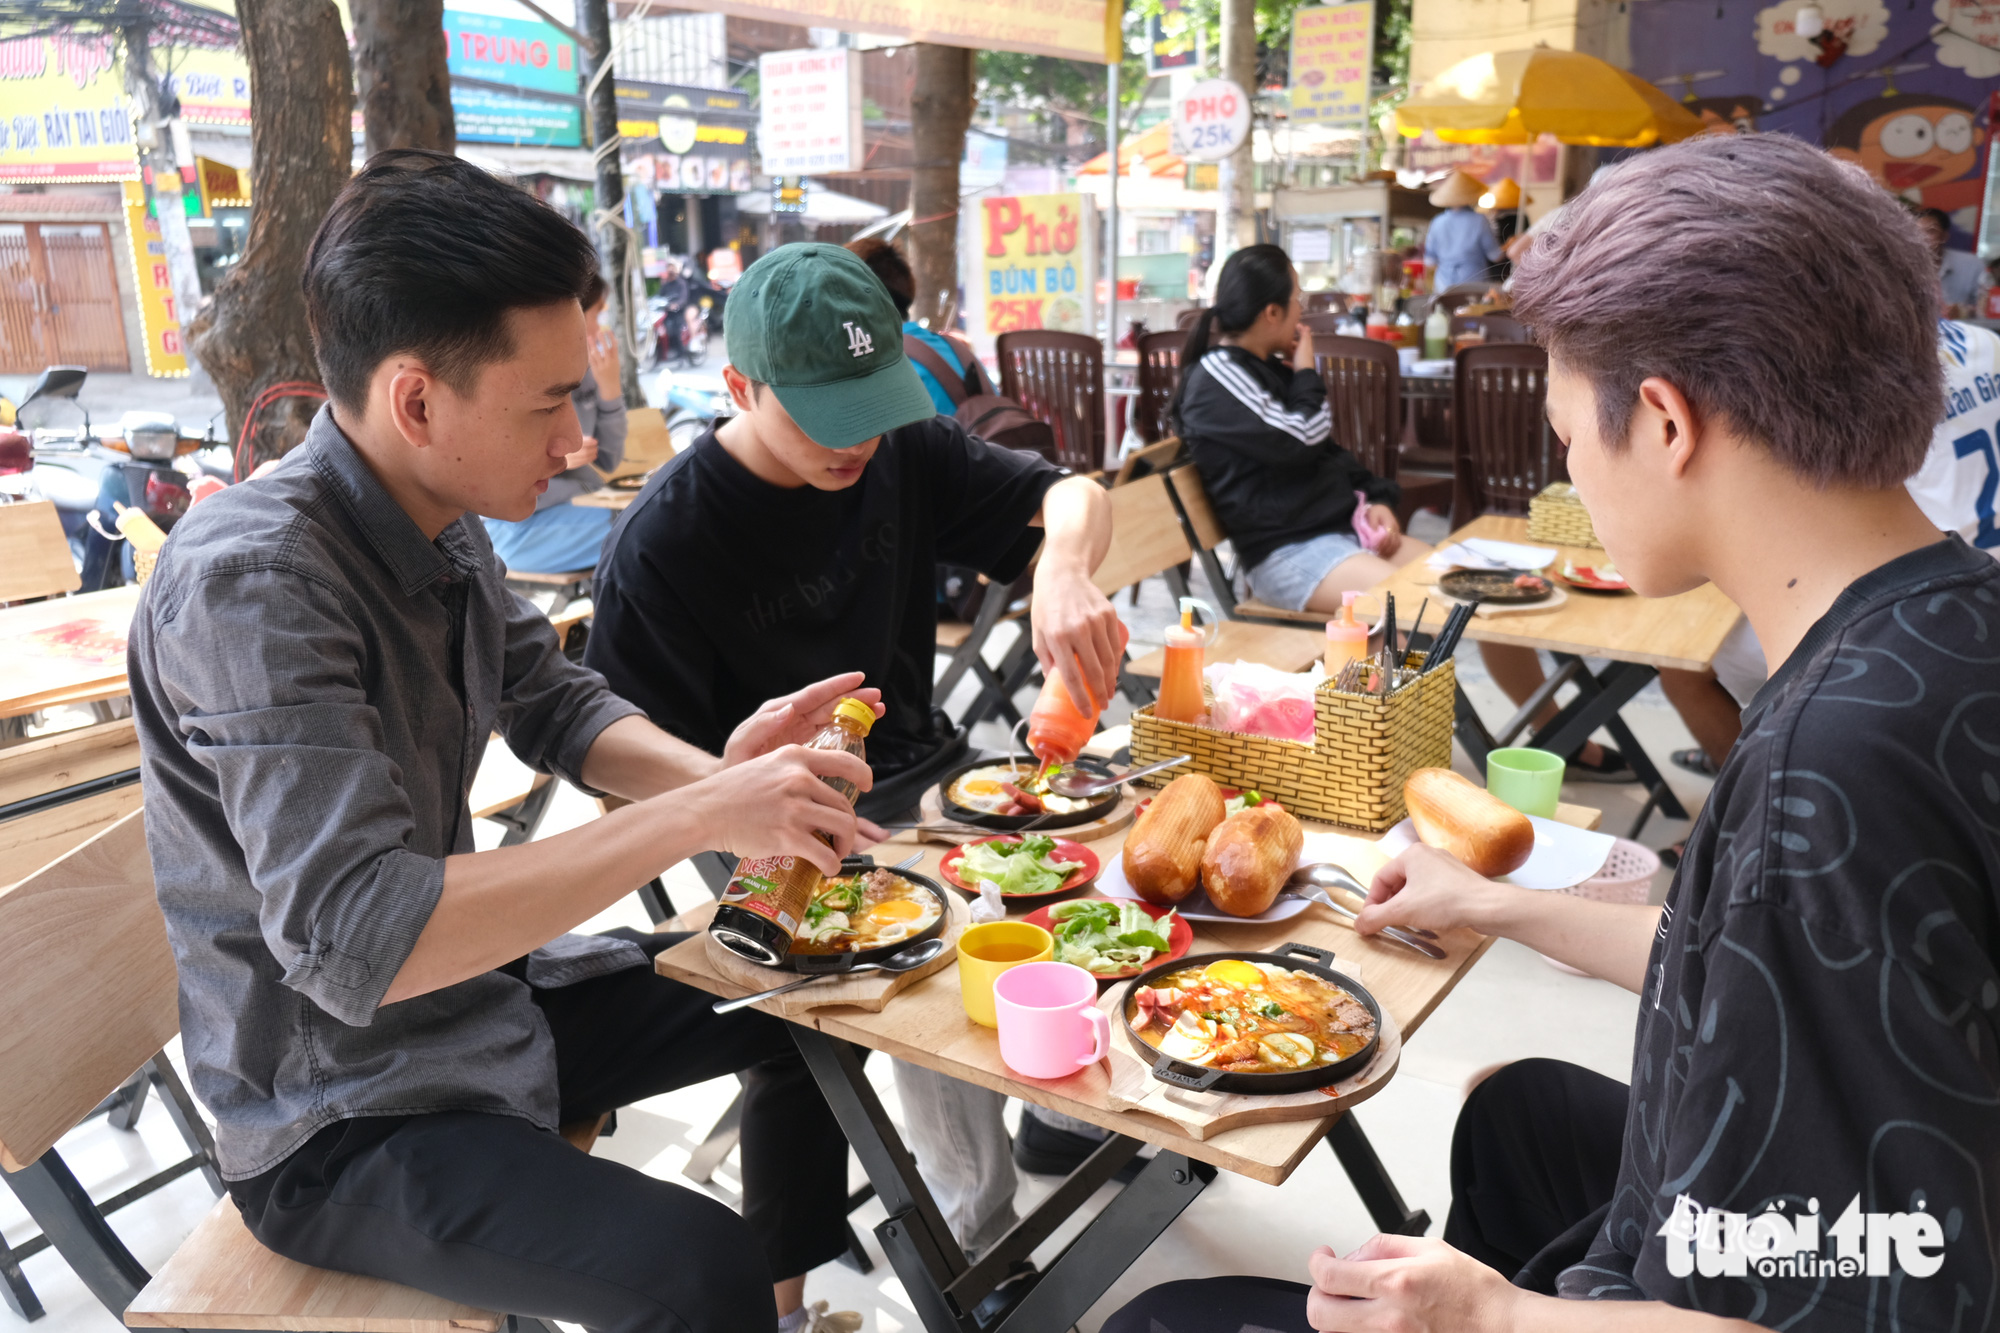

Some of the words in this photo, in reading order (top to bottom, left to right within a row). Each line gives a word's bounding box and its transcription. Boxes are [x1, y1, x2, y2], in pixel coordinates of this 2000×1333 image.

[459, 32, 549, 68] TRUNG
[74, 110, 98, 147] TAI
[982, 196, 1079, 257] Phở
[989, 264, 1037, 295] BÚN
[1044, 260, 1077, 293] BÒ
[988, 299, 1044, 333] 25K
[842, 321, 875, 358] LA
